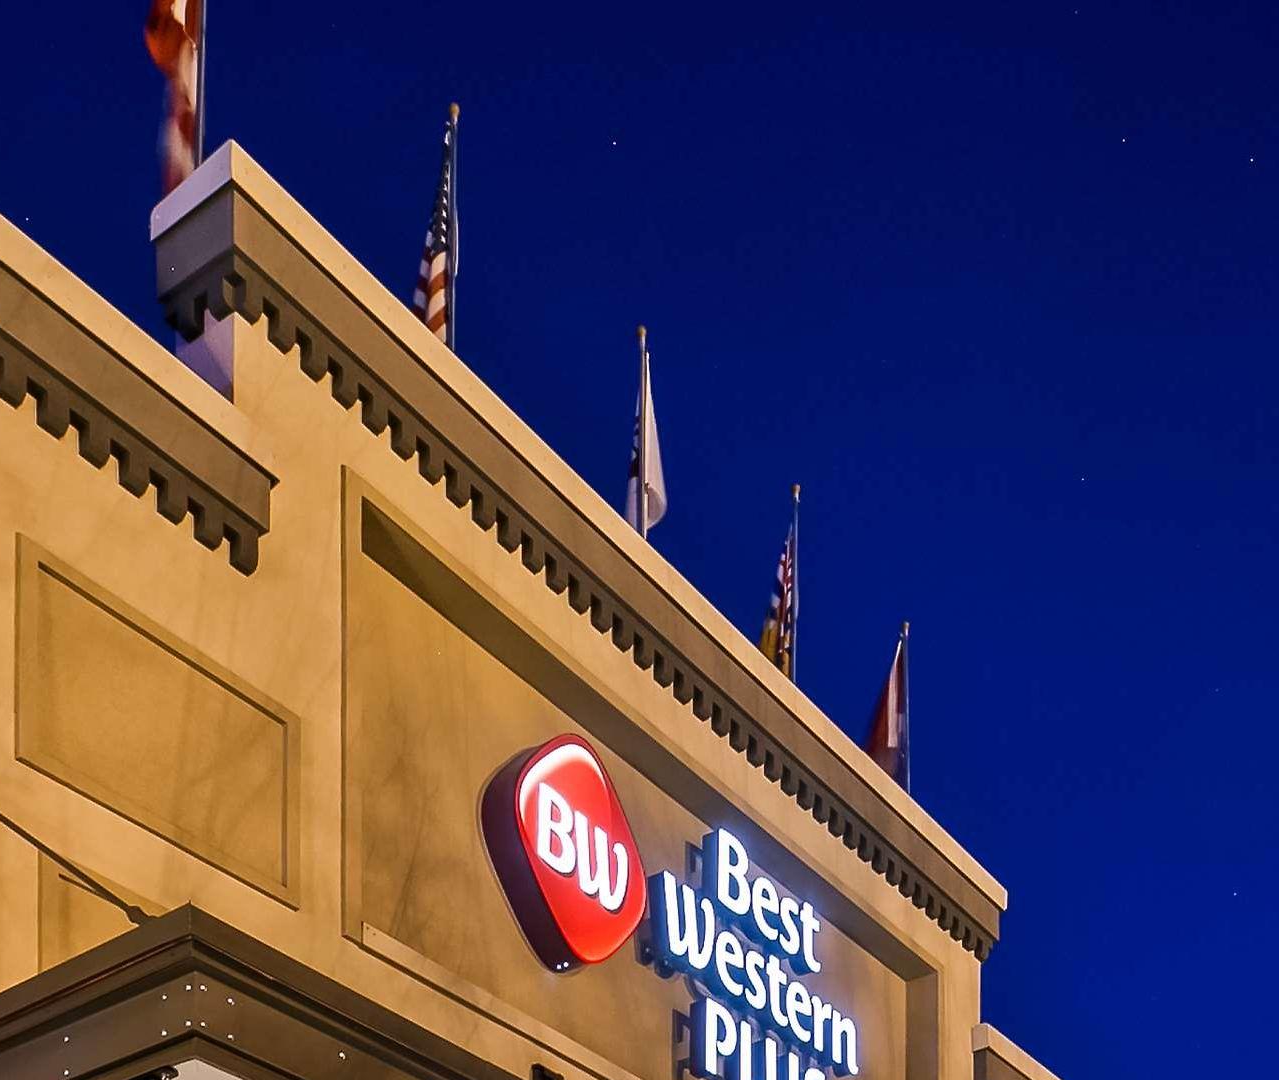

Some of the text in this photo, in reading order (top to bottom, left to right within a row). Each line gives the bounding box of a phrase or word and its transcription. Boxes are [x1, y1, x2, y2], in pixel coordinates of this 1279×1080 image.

[536, 782, 628, 911] BW
[718, 828, 821, 973] Best
[663, 870, 859, 1075] Western
